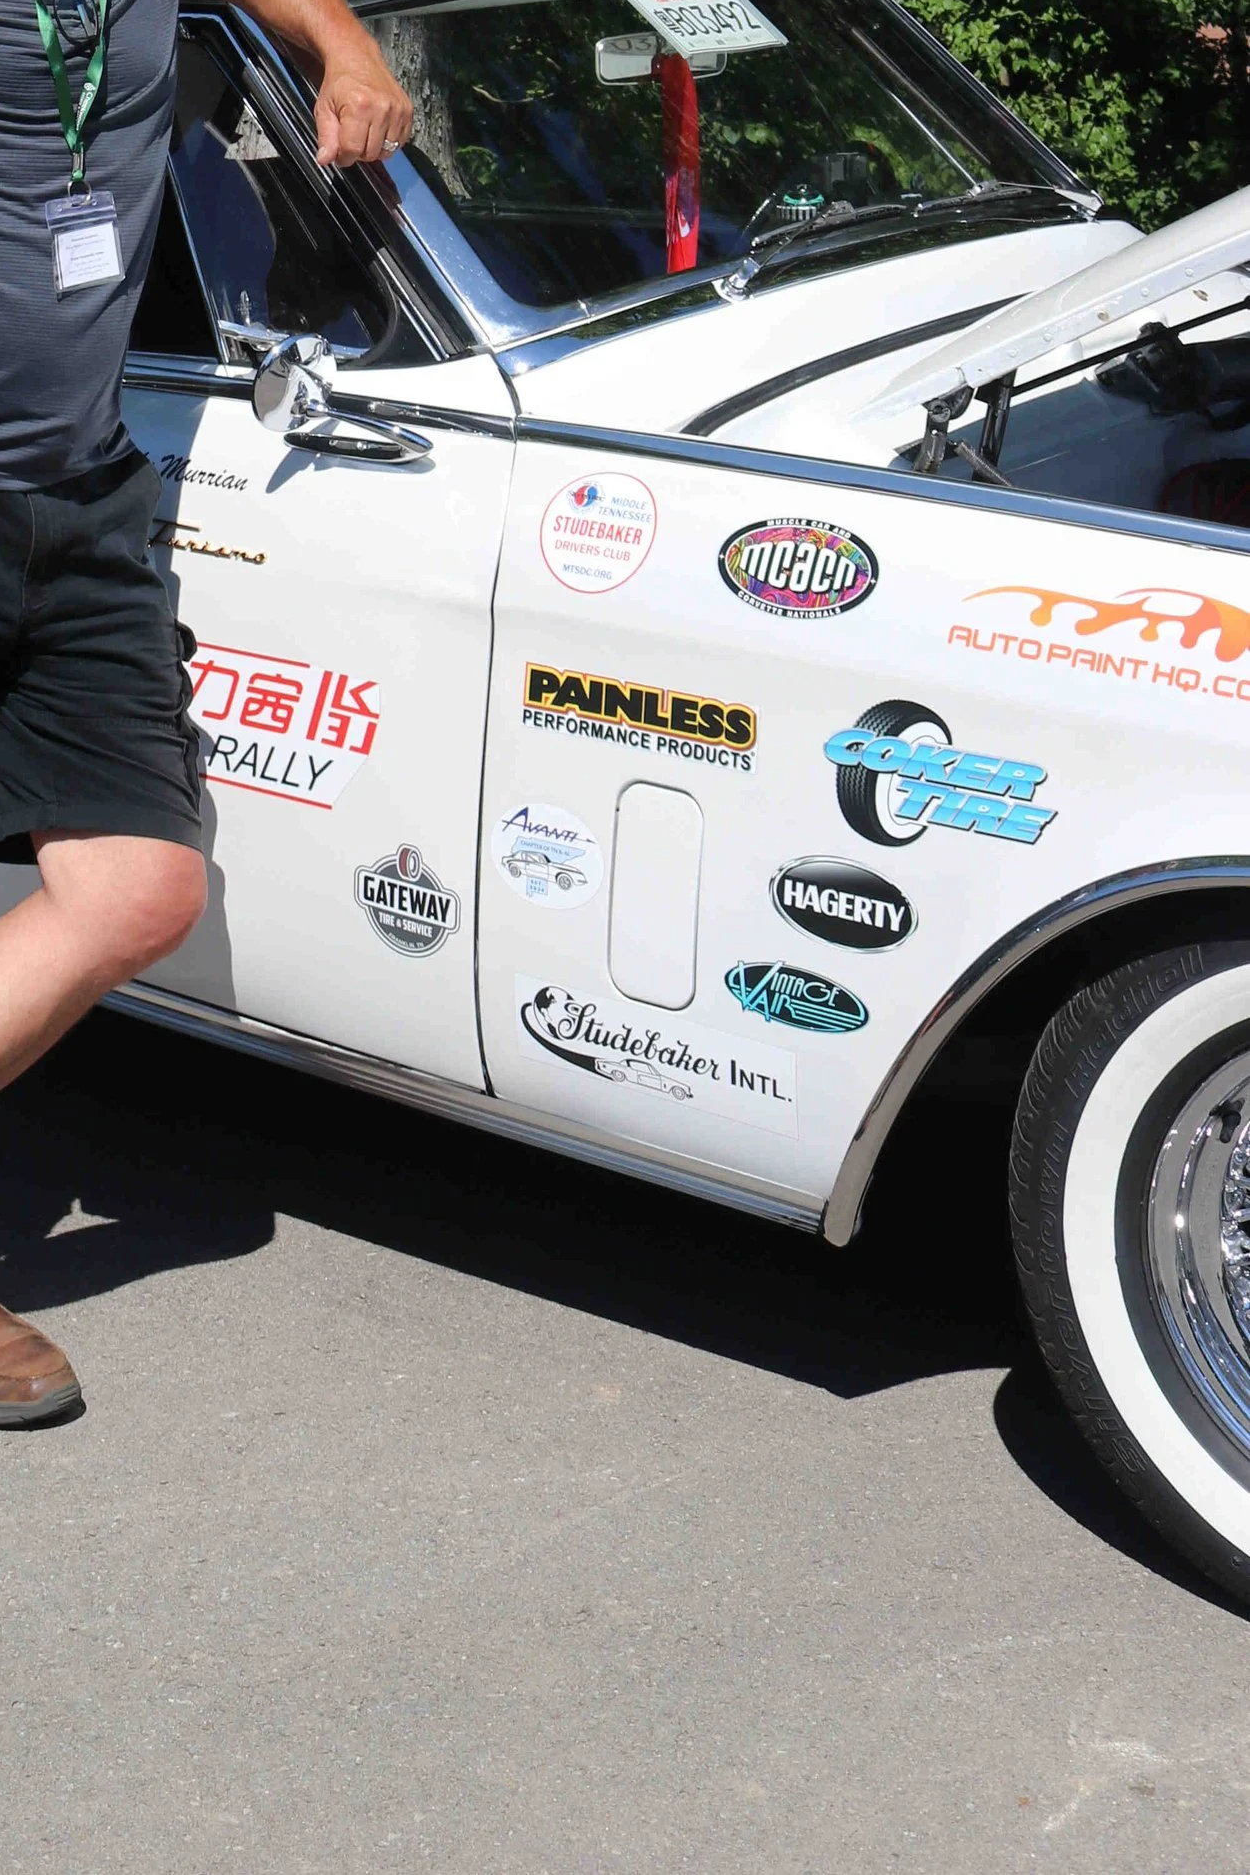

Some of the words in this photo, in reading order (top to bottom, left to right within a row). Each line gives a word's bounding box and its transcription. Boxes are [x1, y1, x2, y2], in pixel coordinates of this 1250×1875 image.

[653, 1, 762, 37] 粤B03492
[160, 454, 248, 491] Murrian
[599, 506, 653, 523] TENNESSEE
[611, 497, 647, 510] MIDDLE
[553, 515, 643, 545] STUDEBAKER
[555, 539, 600, 556] DRIVERS
[603, 548, 631, 561] CLUB
[767, 519, 807, 527] MUSCLE
[811, 520, 830, 531] CAR
[833, 528, 852, 540] AND
[737, 590, 784, 617] CORVETTE
[786, 606, 842, 620] NATIONALS
[947, 625, 1042, 660] AUTO
[1046, 643, 1149, 680] PAINT
[528, 667, 752, 746] PAINLESS
[207, 734, 334, 792] RALLY
[523, 709, 651, 749] PERFORMANCE
[656, 736, 752, 772] PRODUCTS
[823, 728, 1048, 801] COKER
[894, 779, 1058, 845] TIRE
[364, 875, 451, 923] GATEWAY
[783, 878, 906, 932] HAGERTY
[378, 911, 395, 927] TIRE
[396, 919, 402, 928] &
[403, 919, 433, 938] SERVICE
[737, 960, 840, 1012] VINTAGE
[558, 1002, 720, 1080] Studebaker
[730, 1059, 793, 1103] INTL.
